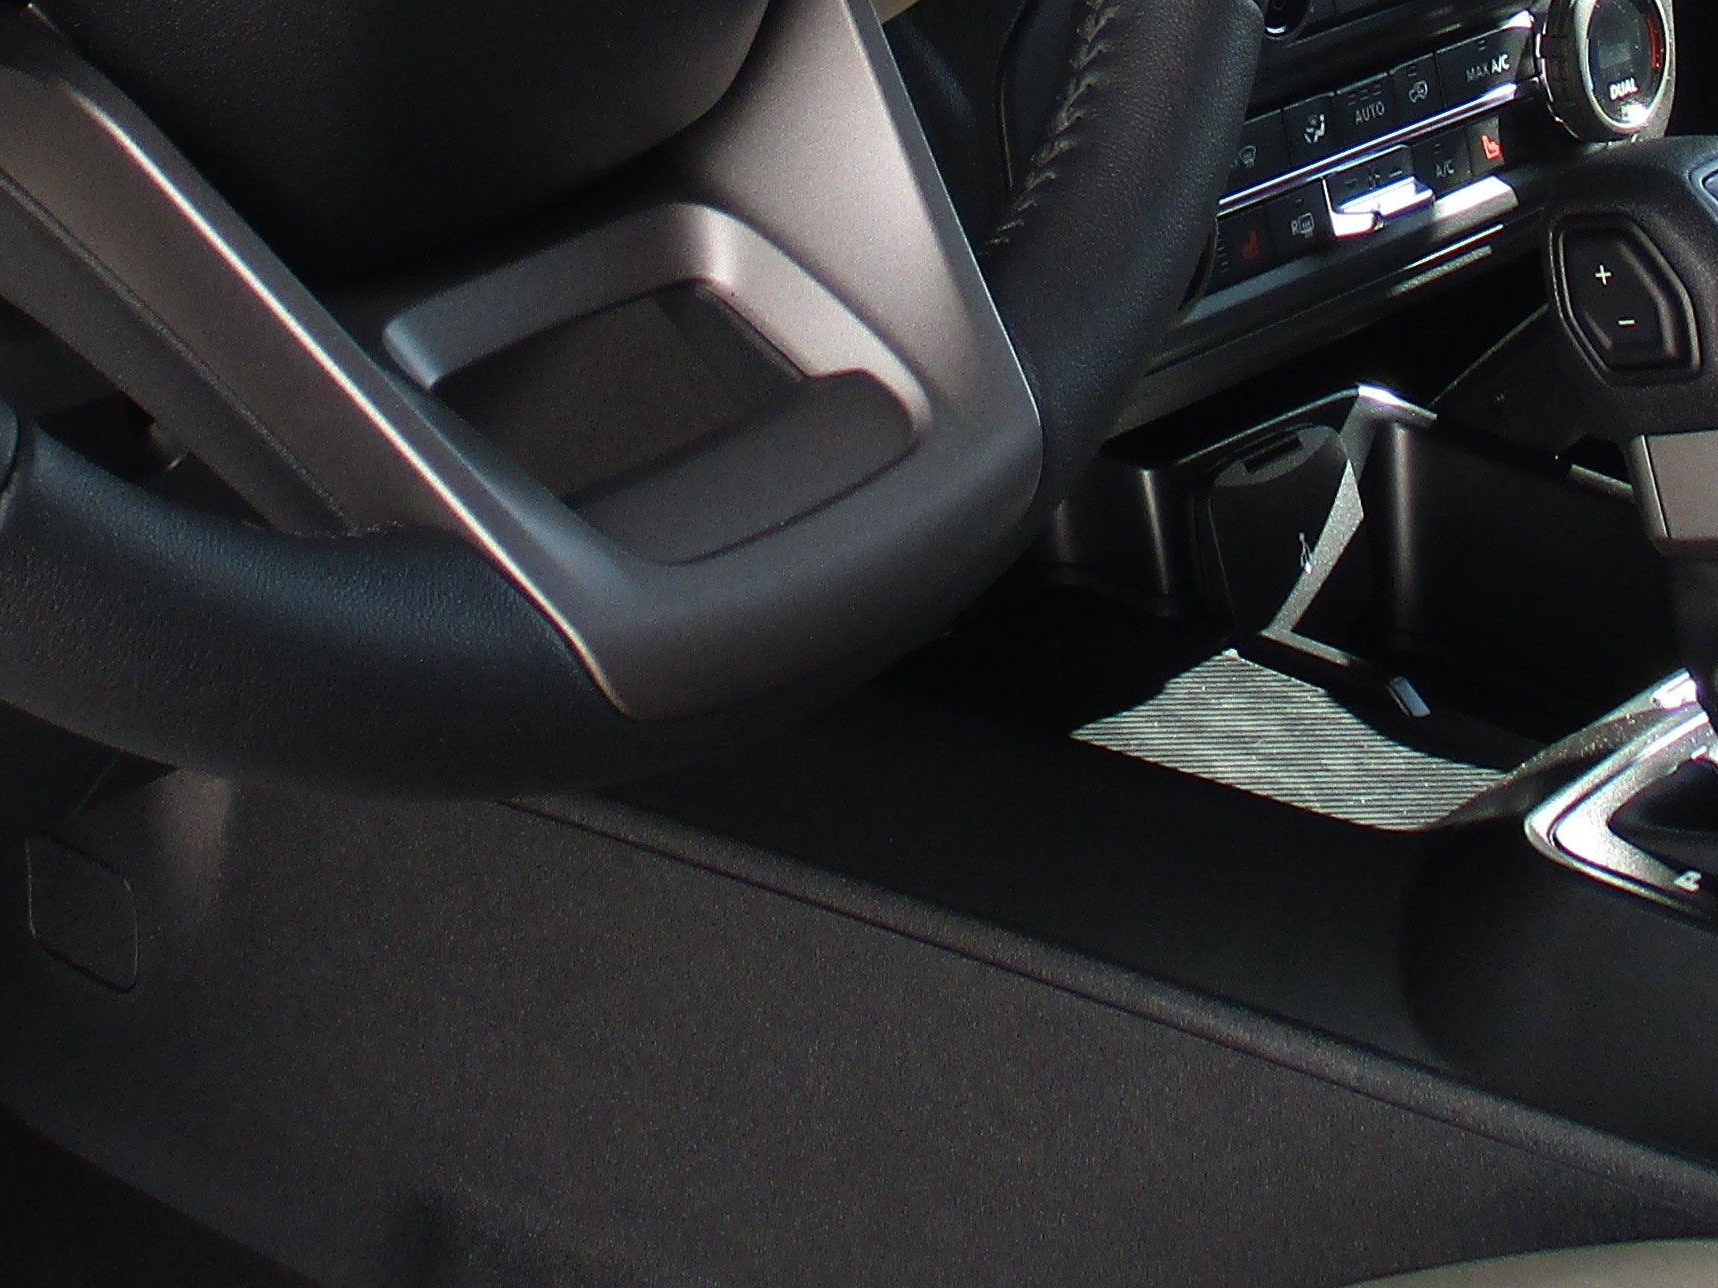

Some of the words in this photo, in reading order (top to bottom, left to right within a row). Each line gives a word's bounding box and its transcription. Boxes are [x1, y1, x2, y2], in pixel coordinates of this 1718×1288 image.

[1490, 53, 1511, 75] A/C
[1608, 76, 1639, 101] DUAL
[1354, 99, 1386, 126] AUTO
[1435, 158, 1455, 179] A/C
